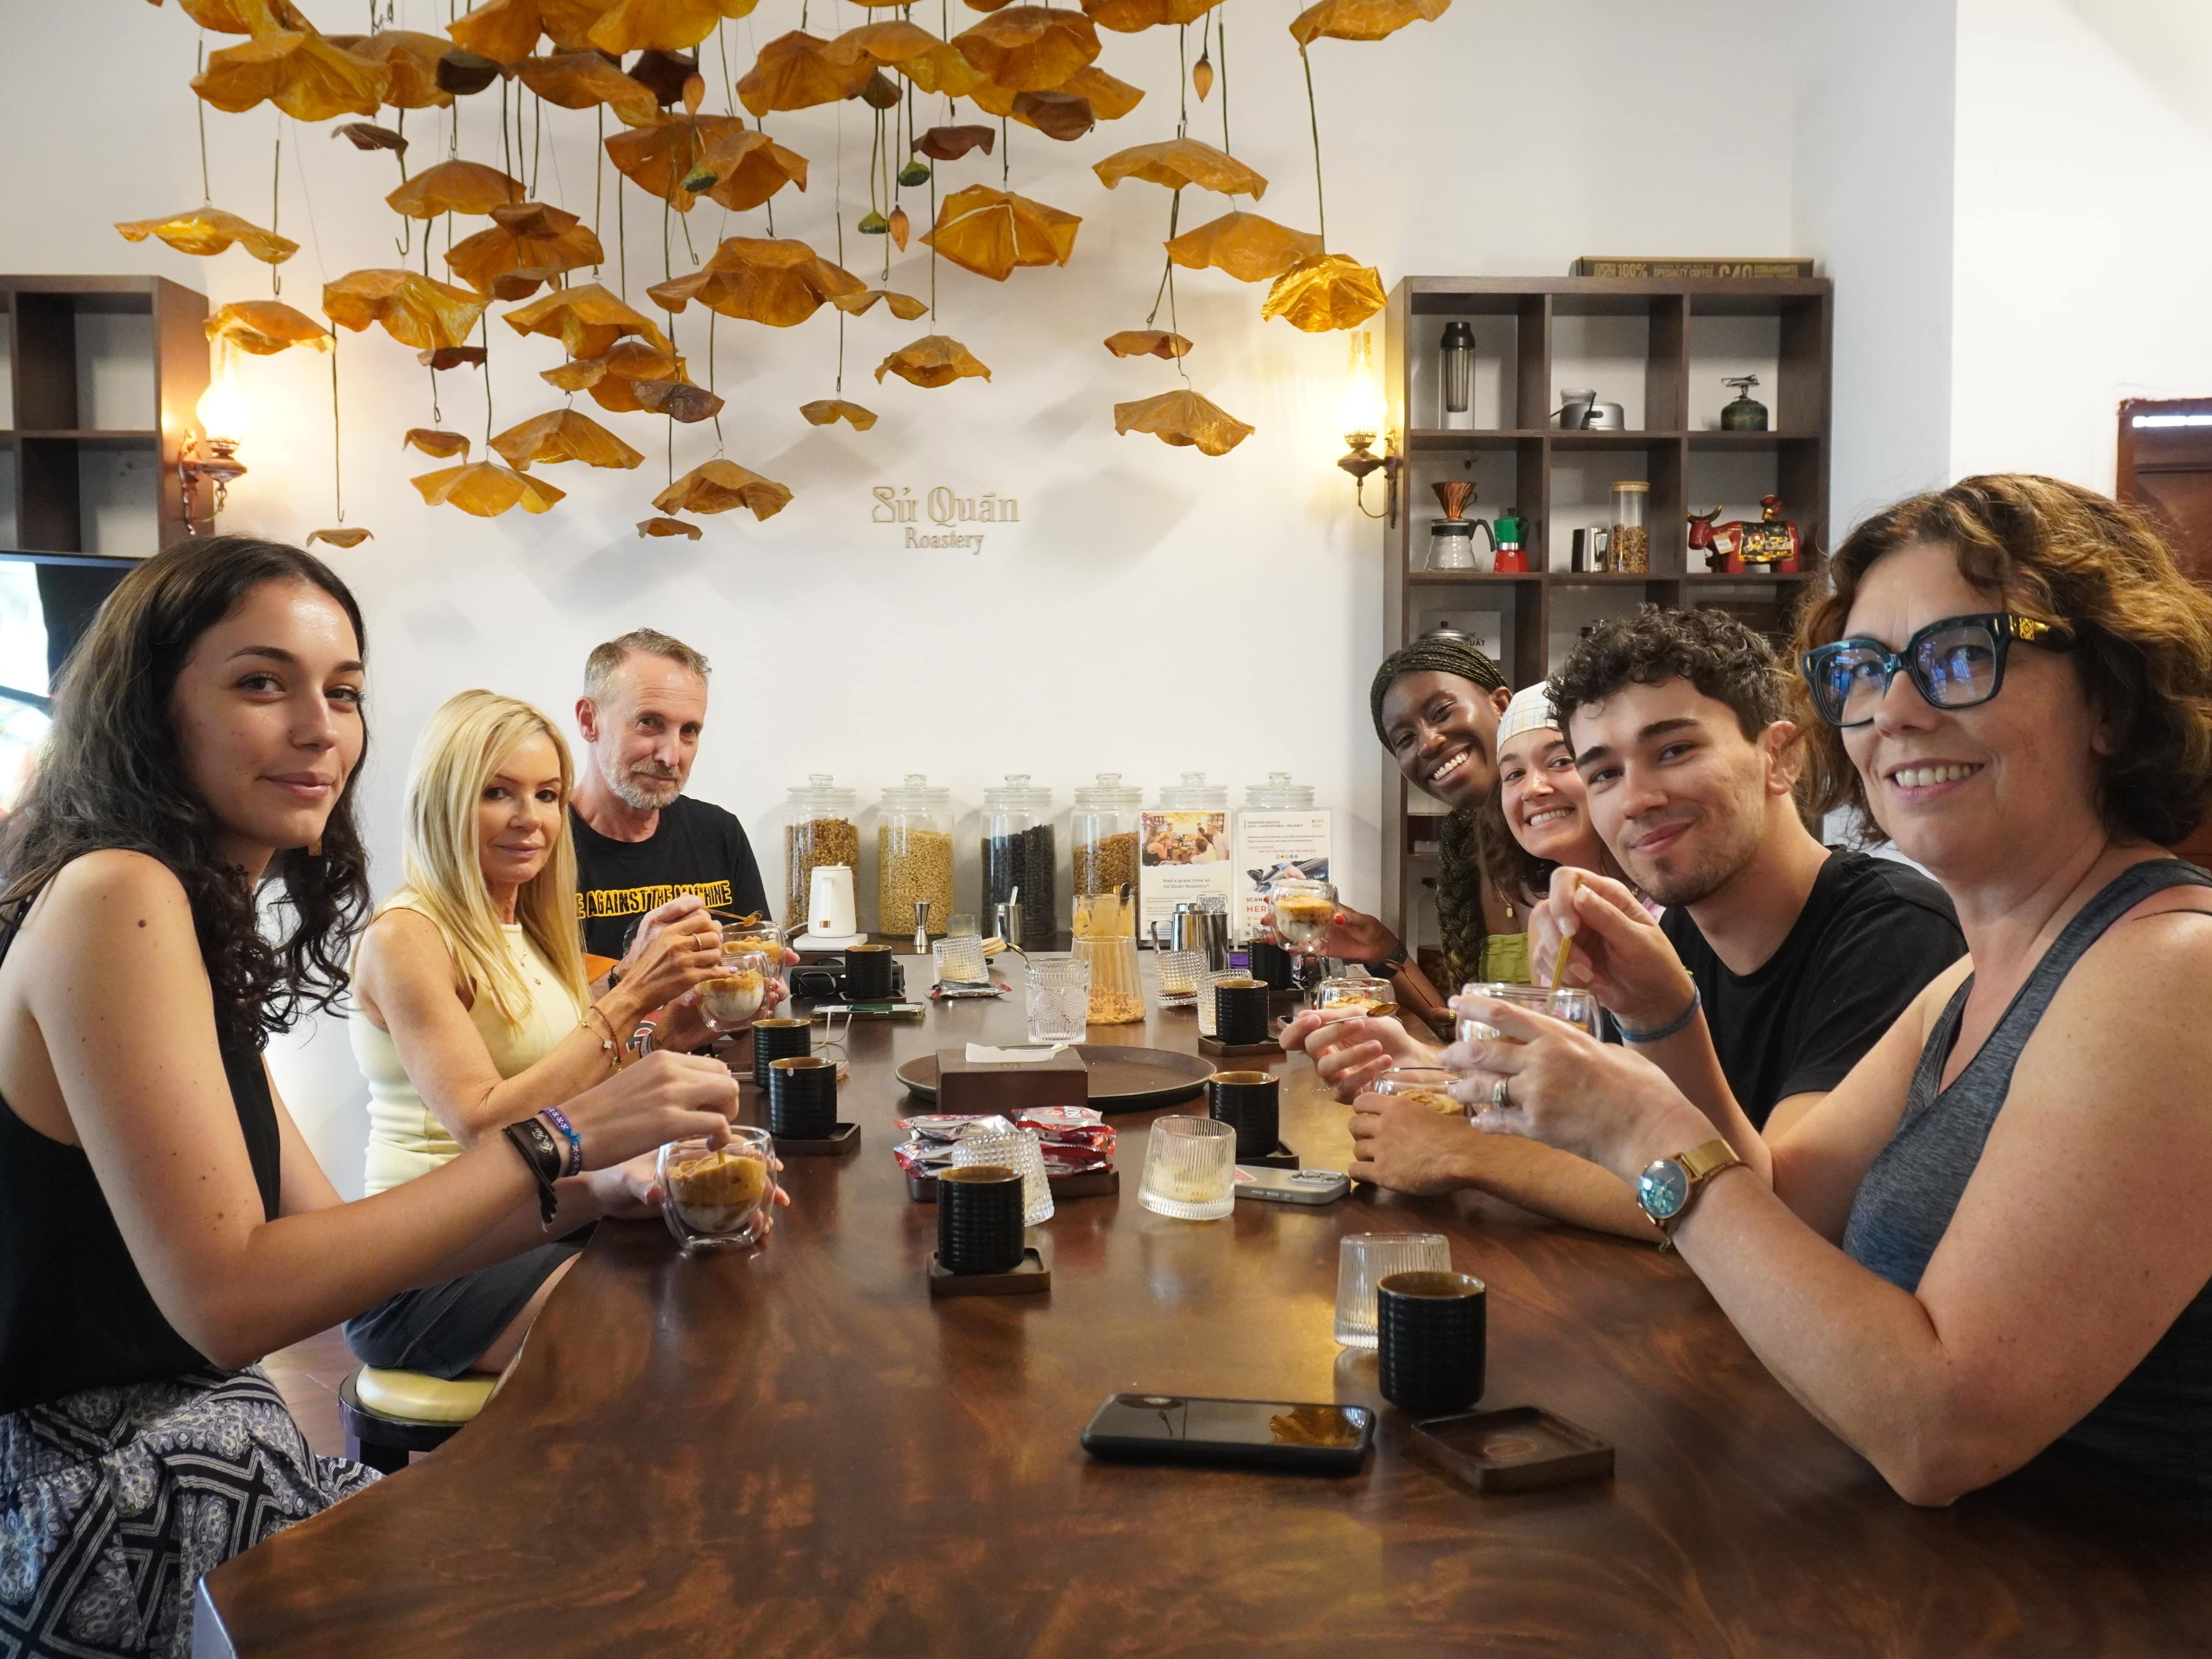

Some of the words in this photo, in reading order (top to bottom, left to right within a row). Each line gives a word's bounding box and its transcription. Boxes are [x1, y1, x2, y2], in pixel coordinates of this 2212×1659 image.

[1617, 263, 1648, 277] 100%
[905, 527, 985, 555] Roastery
[586, 887, 646, 918] AGAINST
